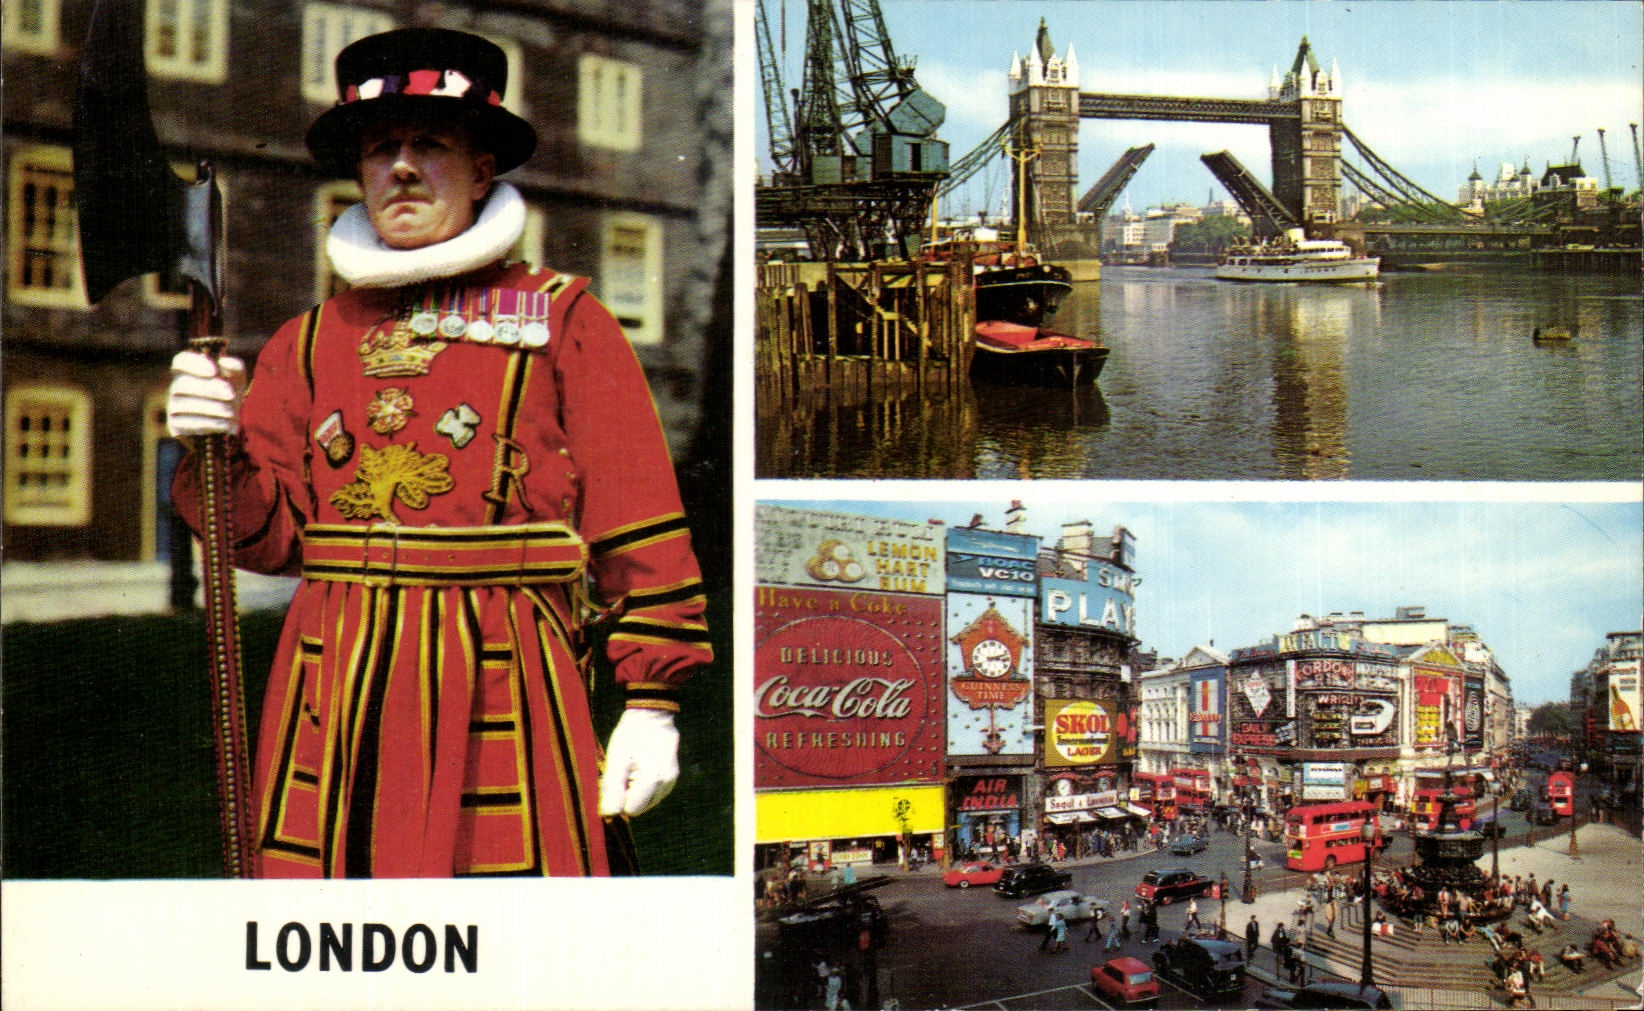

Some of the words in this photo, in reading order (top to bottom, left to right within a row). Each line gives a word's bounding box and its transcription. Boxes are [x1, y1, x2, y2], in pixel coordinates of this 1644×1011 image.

[867, 540, 938, 562] LEMON
[876, 558, 930, 577] HART
[977, 556, 1034, 571] BOAC
[978, 567, 1035, 582] VC10
[879, 576, 927, 593] RUM
[759, 587, 818, 610] Have
[829, 599, 841, 612] a
[851, 592, 908, 616] Coke
[780, 647, 893, 667] DELICIOUS
[961, 682, 1022, 692] GUINNESS
[977, 691, 1005, 700] TIME
[754, 674, 916, 720] Coca-Cola
[1055, 714, 1111, 734] SKOL
[766, 732, 905, 749] REFRESHING
[1067, 747, 1103, 757] LAGER
[972, 778, 1007, 793] AIR
[961, 794, 1018, 810] INDIA
